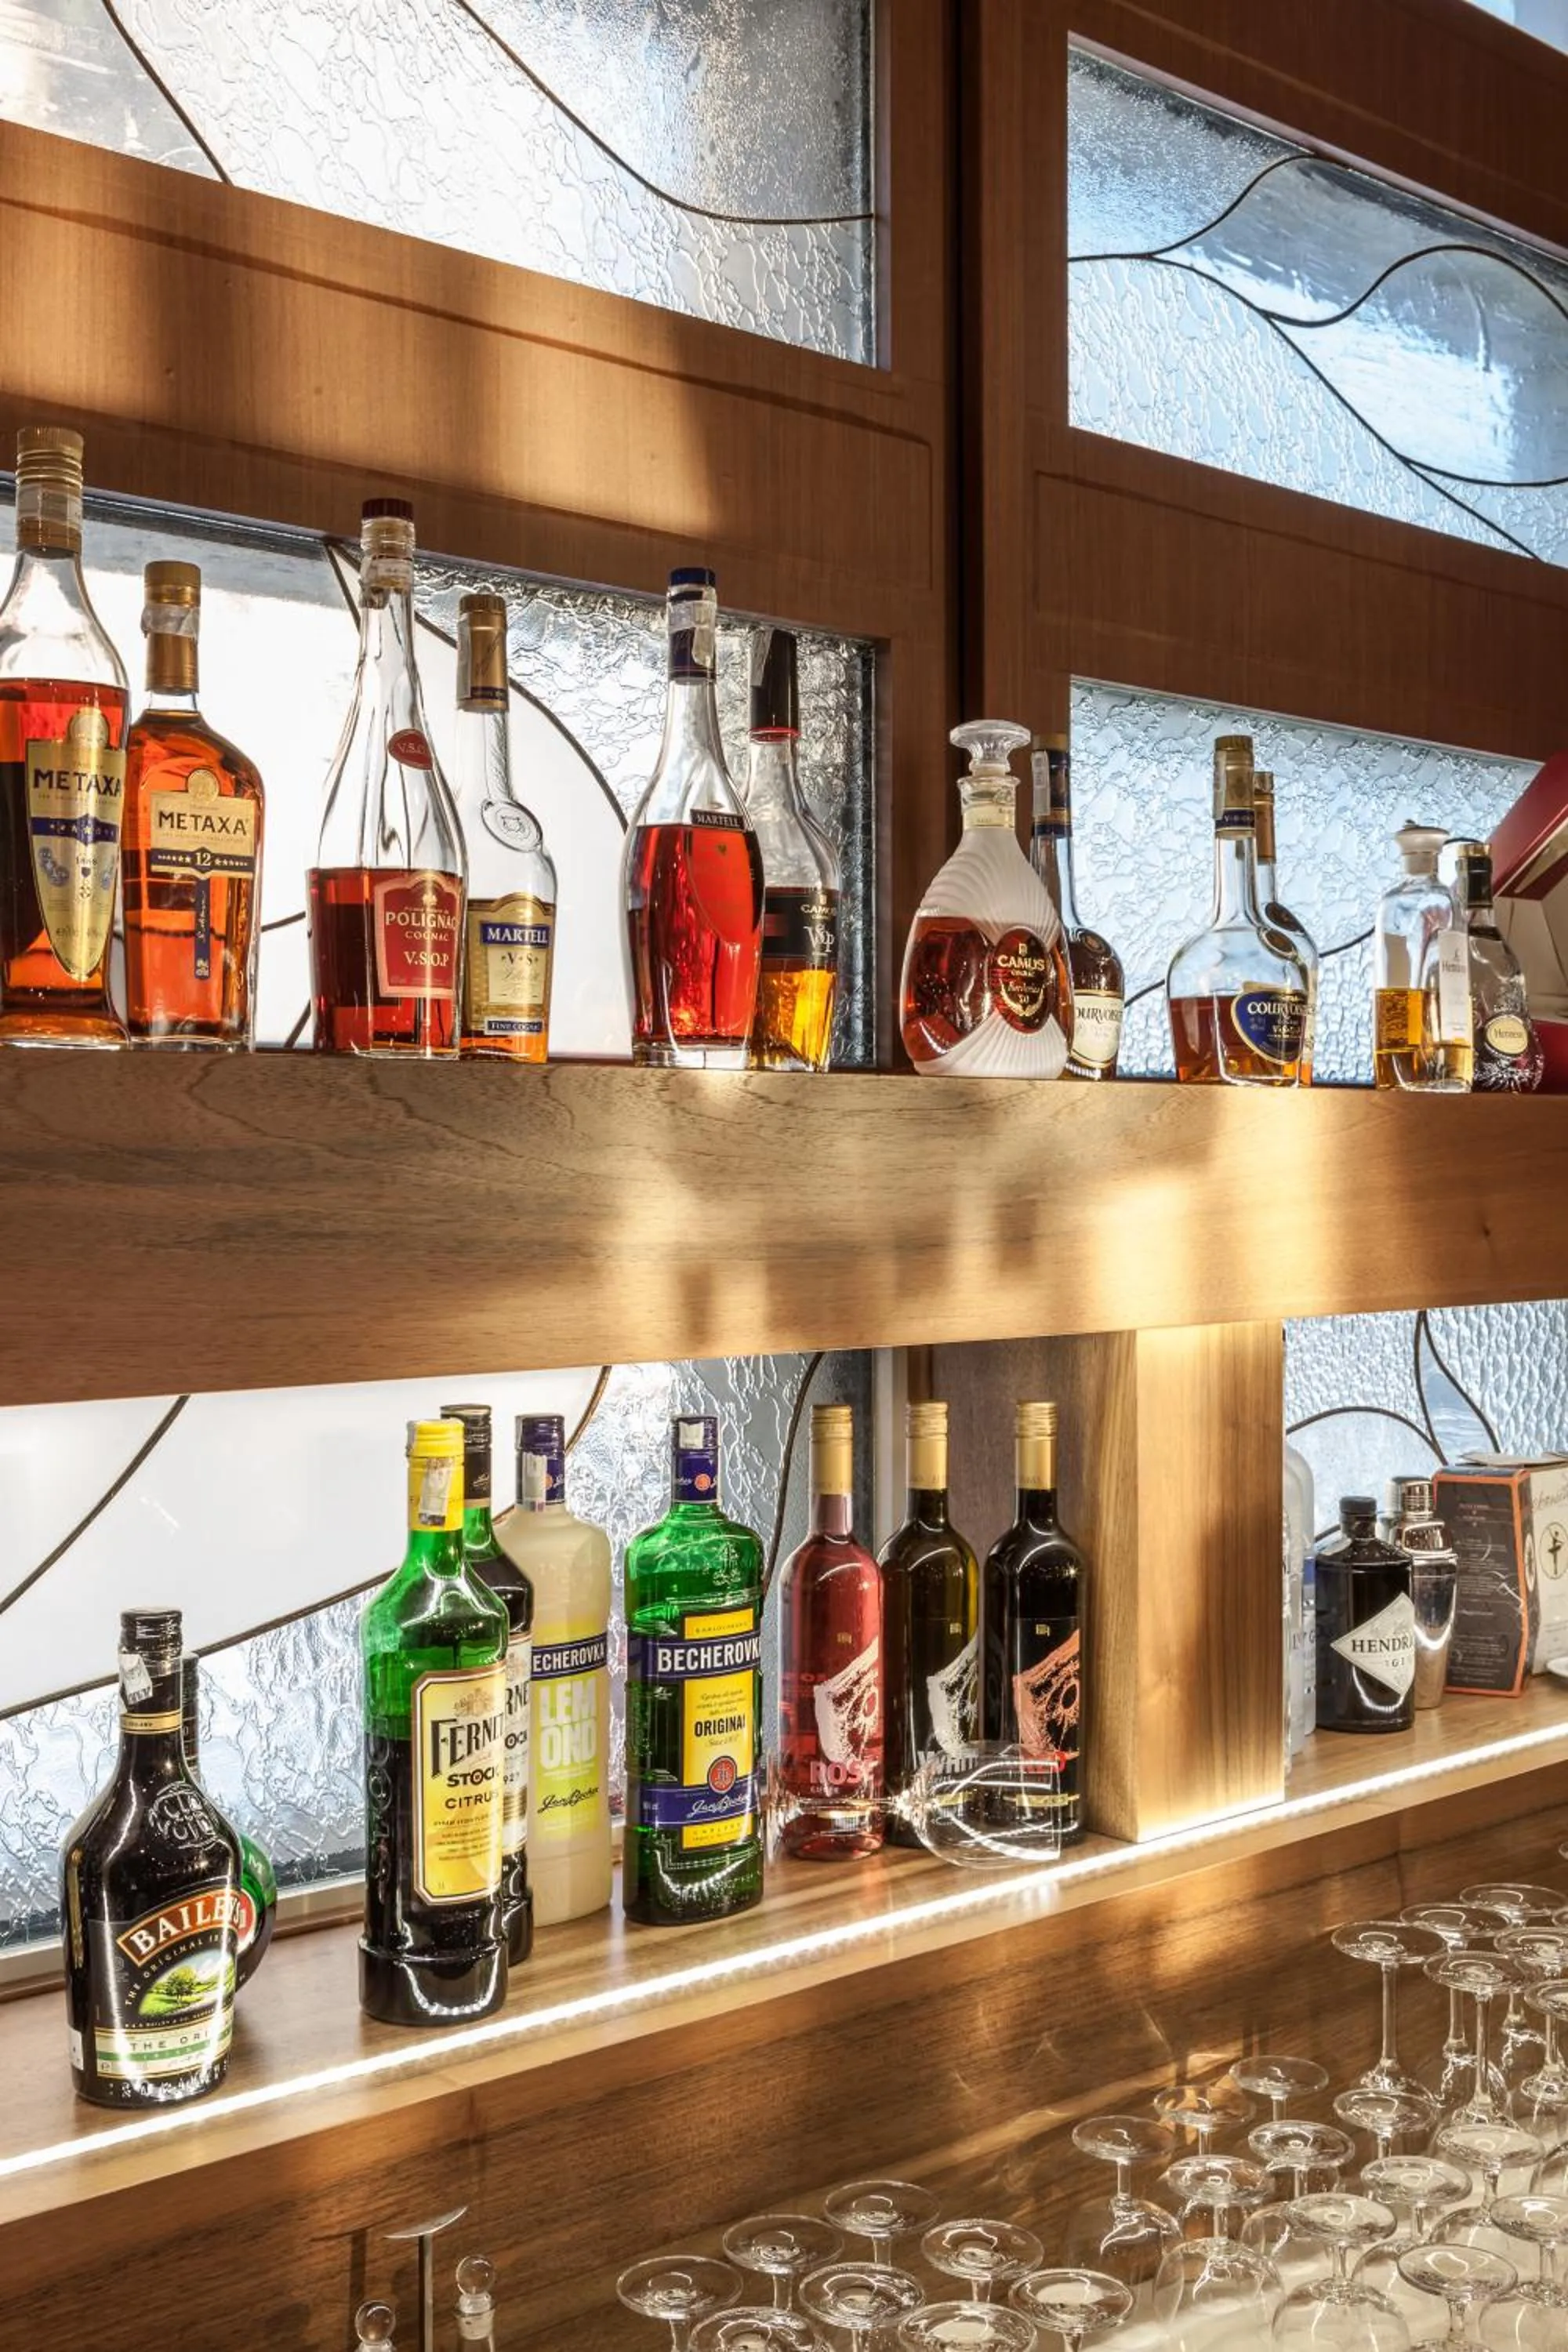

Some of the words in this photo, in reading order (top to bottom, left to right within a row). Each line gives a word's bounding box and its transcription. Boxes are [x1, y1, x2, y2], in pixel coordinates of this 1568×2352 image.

[158, 811, 247, 836] METAXA
[697, 814, 741, 827] MARTELL
[195, 852, 212, 866] 12
[405, 931, 450, 942] COGNAC
[487, 927, 548, 943] MARTELL
[997, 955, 1045, 971] CAMUS
[1352, 1636, 1411, 1653] HENDR
[533, 1642, 605, 1672] ECHEROVKA
[657, 1636, 760, 1672] BECHEROVK
[539, 1678, 597, 1726] LEM
[539, 1720, 597, 1770] OND
[125, 1983, 141, 2006] THE
[143, 1936, 203, 1979] ORIGINAL
[130, 2040, 167, 2051] THE
